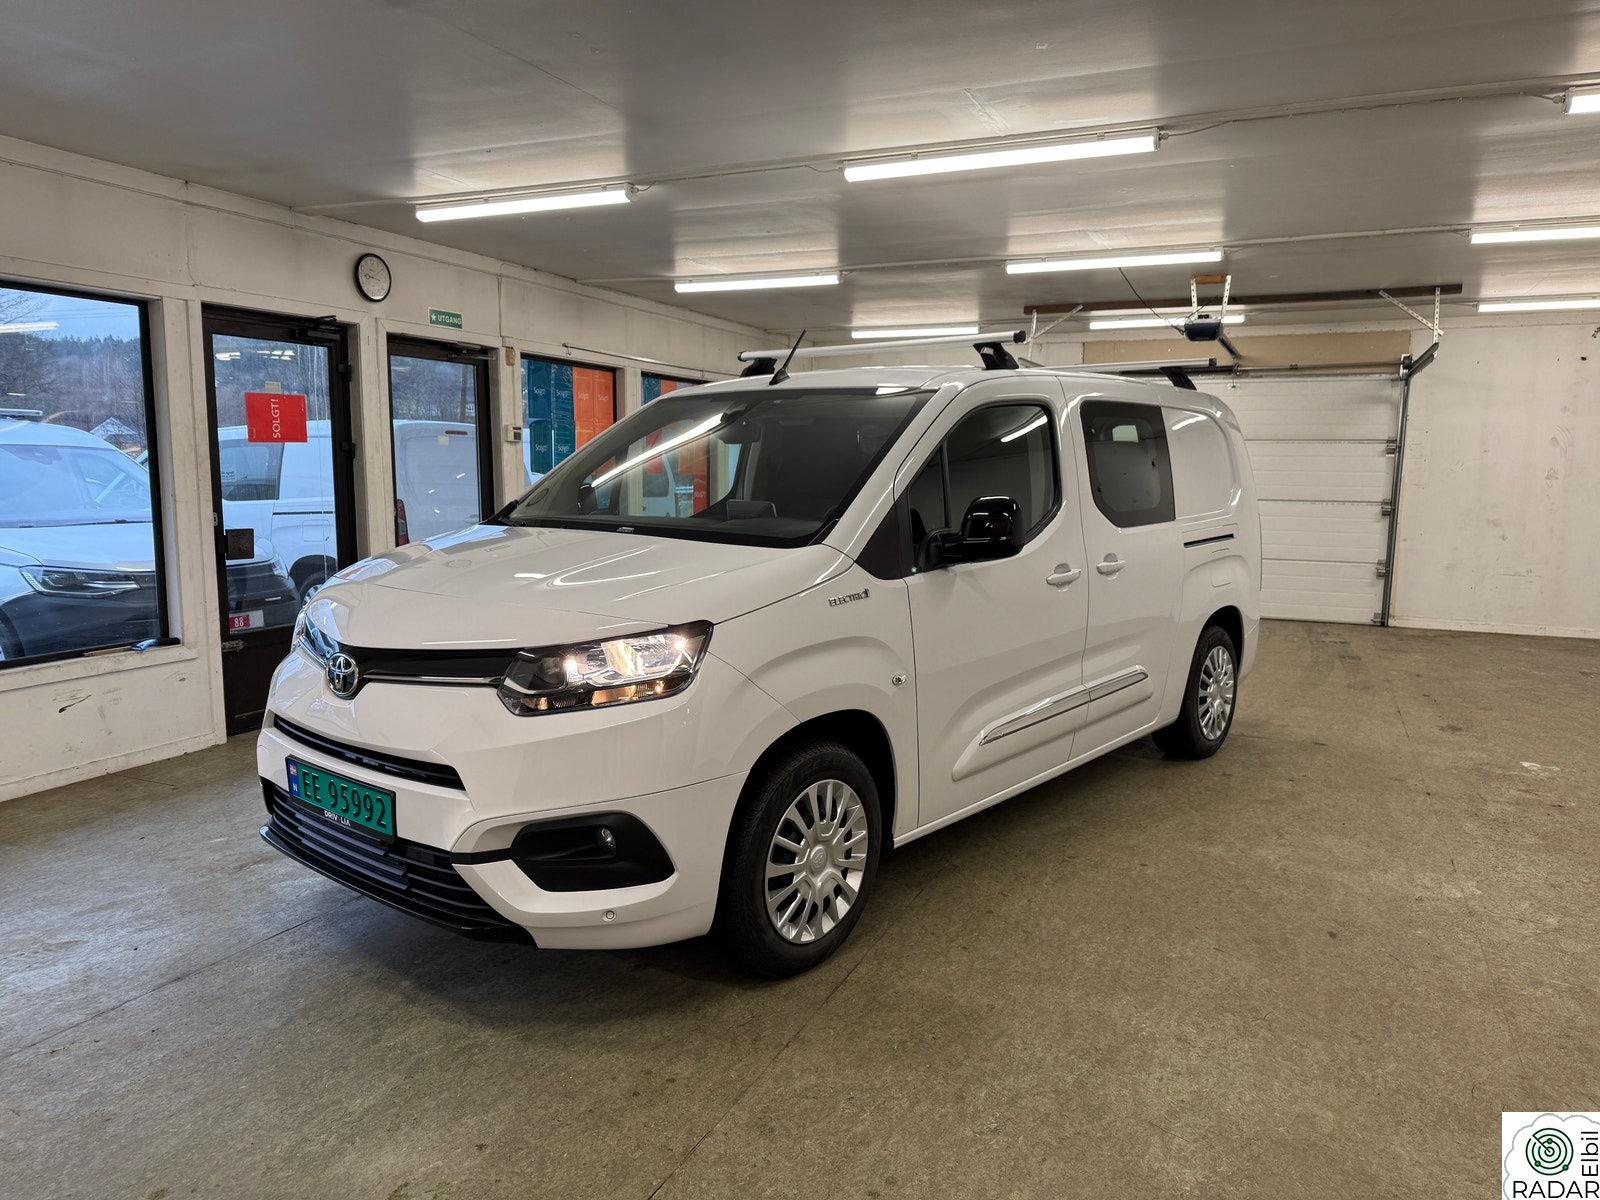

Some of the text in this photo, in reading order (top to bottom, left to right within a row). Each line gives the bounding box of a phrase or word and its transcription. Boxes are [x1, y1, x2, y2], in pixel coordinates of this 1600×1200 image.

[437, 314, 462, 325] UTGANG
[270, 398, 281, 439] SOLGT!
[302, 769, 387, 828] EE 95992
